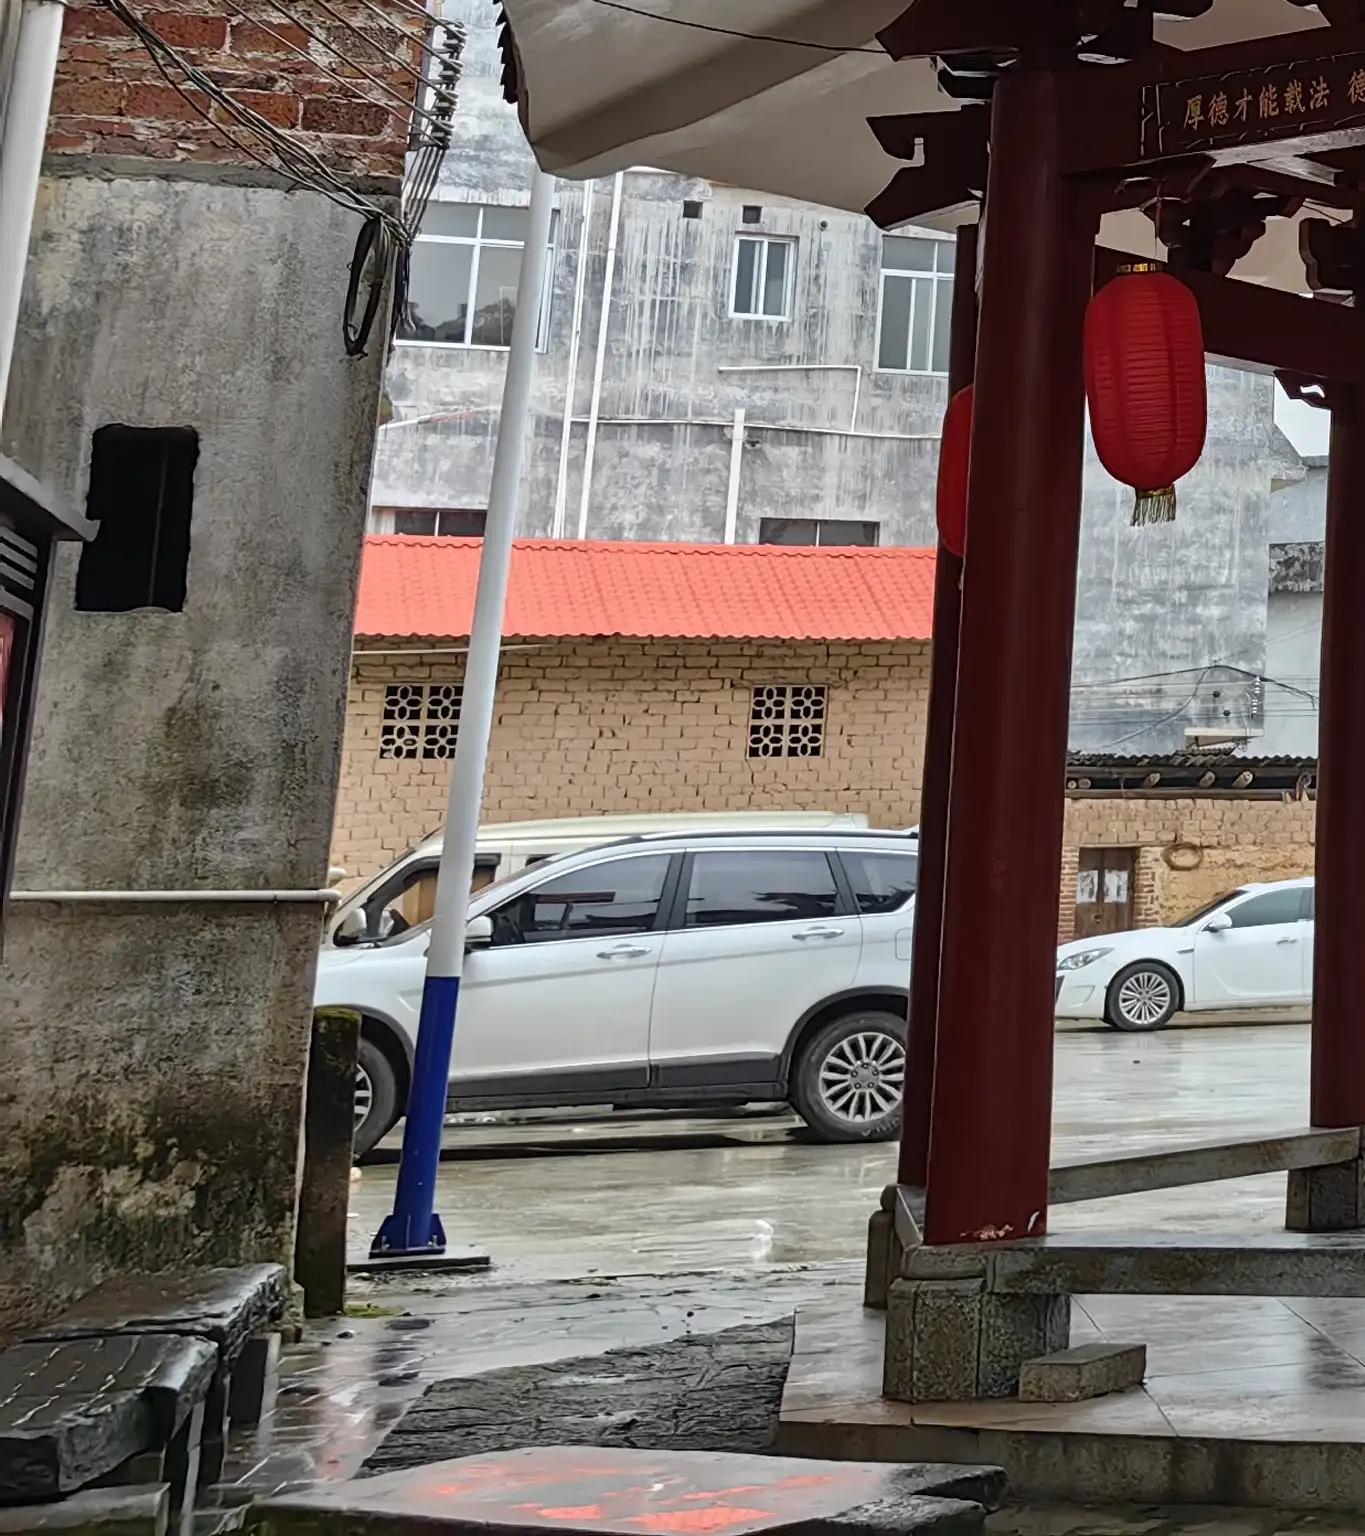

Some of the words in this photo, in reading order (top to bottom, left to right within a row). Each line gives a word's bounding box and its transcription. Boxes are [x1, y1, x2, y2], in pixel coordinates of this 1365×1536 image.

[1183, 76, 1331, 132] 厚德才能载法
